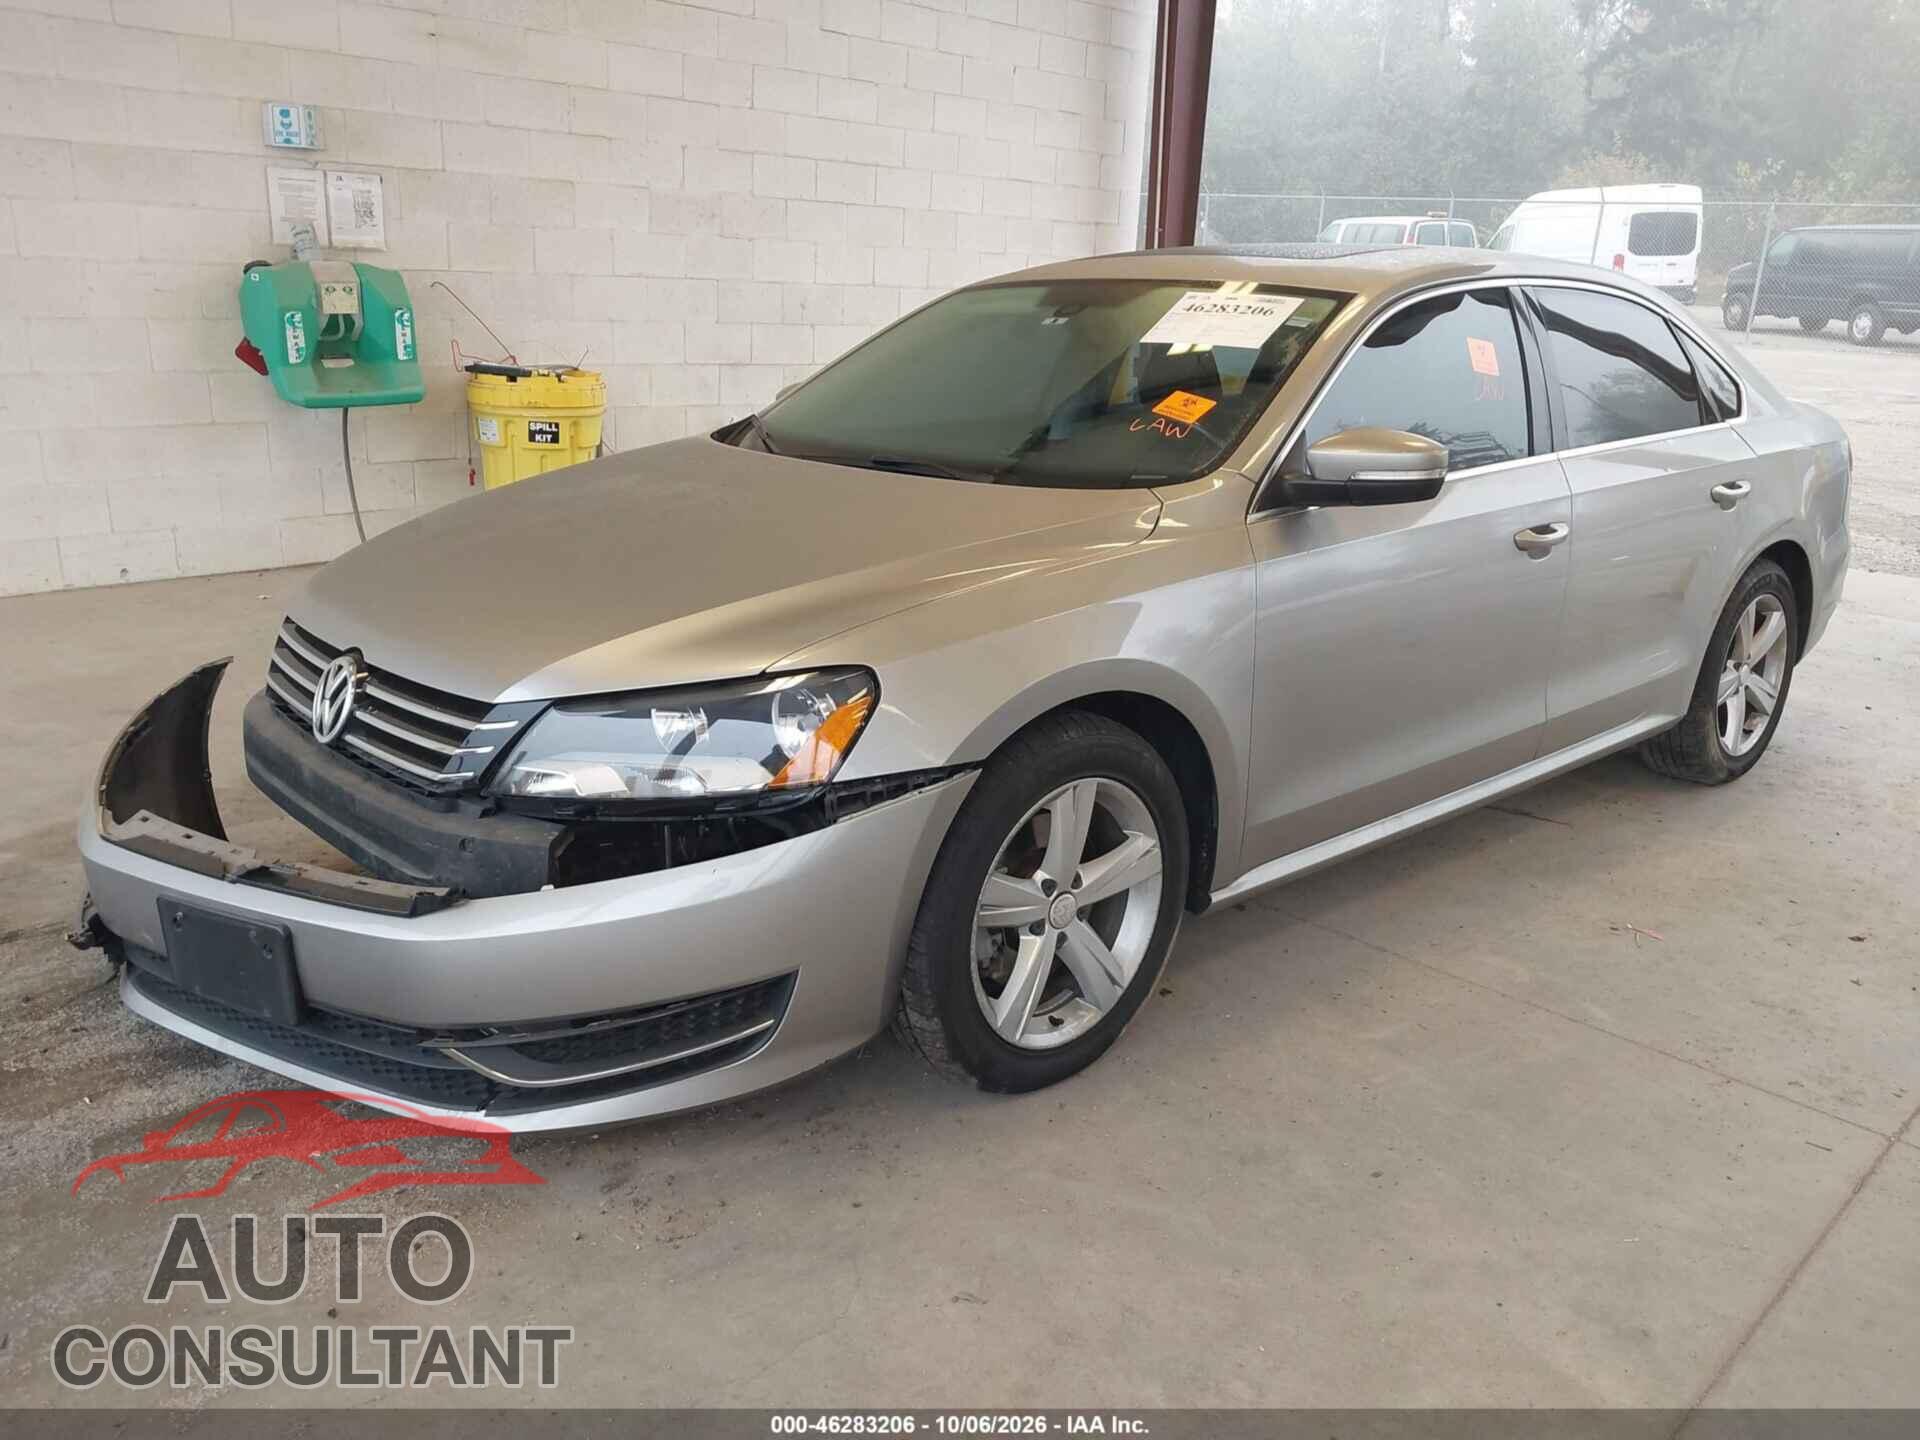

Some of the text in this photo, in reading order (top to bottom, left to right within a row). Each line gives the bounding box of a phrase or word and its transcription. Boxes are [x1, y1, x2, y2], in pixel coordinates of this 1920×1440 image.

[1183, 303, 1275, 317] 46283206
[529, 422, 557, 432] SPILL
[535, 433, 553, 443] KIT
